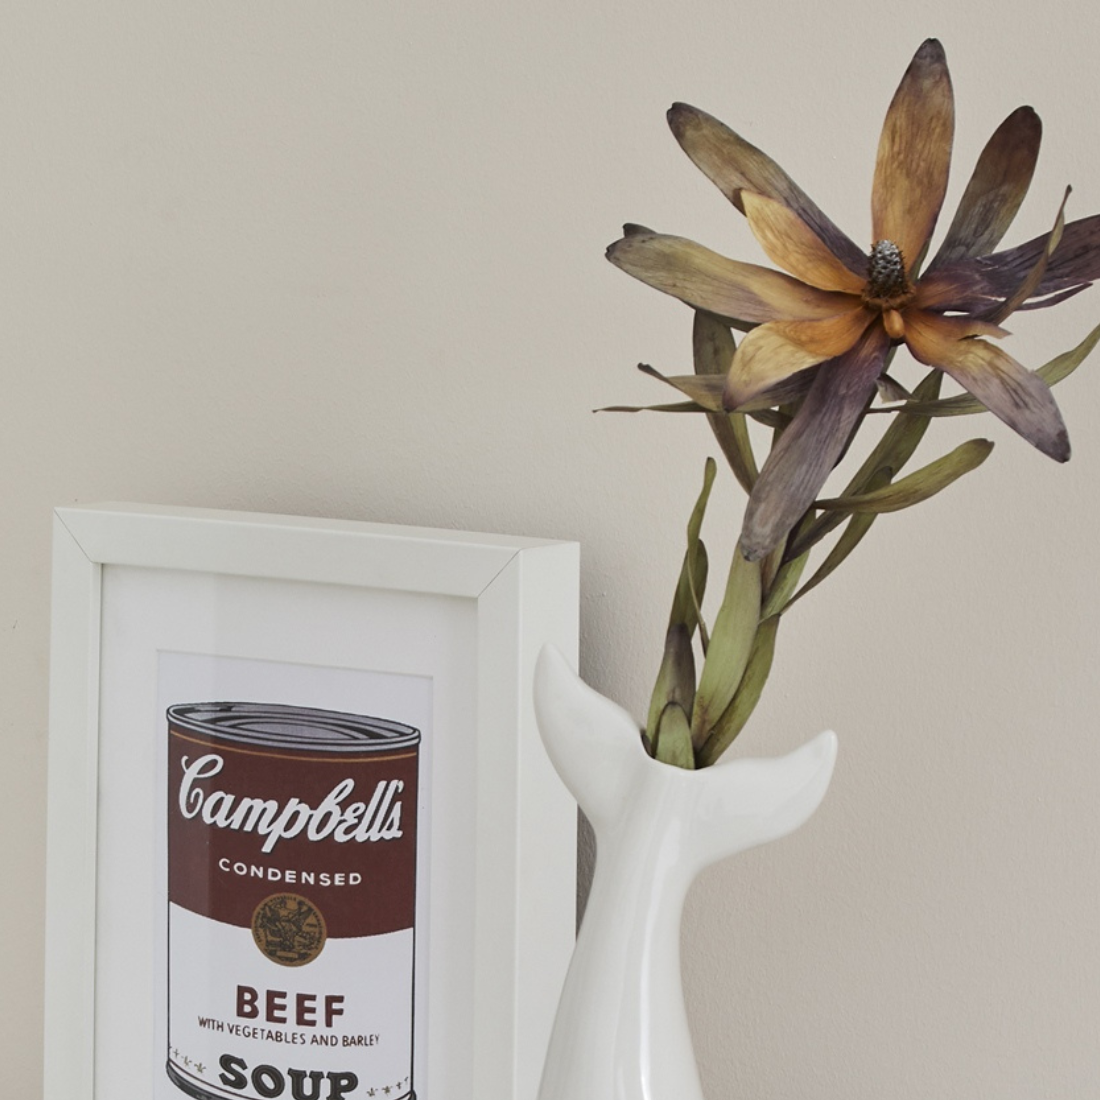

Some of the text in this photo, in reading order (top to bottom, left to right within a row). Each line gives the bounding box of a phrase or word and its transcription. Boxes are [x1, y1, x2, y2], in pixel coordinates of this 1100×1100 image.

[178, 754, 404, 853] Campbell's
[218, 858, 362, 887] CONDENSED
[236, 984, 345, 1028] BEEF
[198, 1015, 380, 1047] WITH VEGETABLES AND BARLEY
